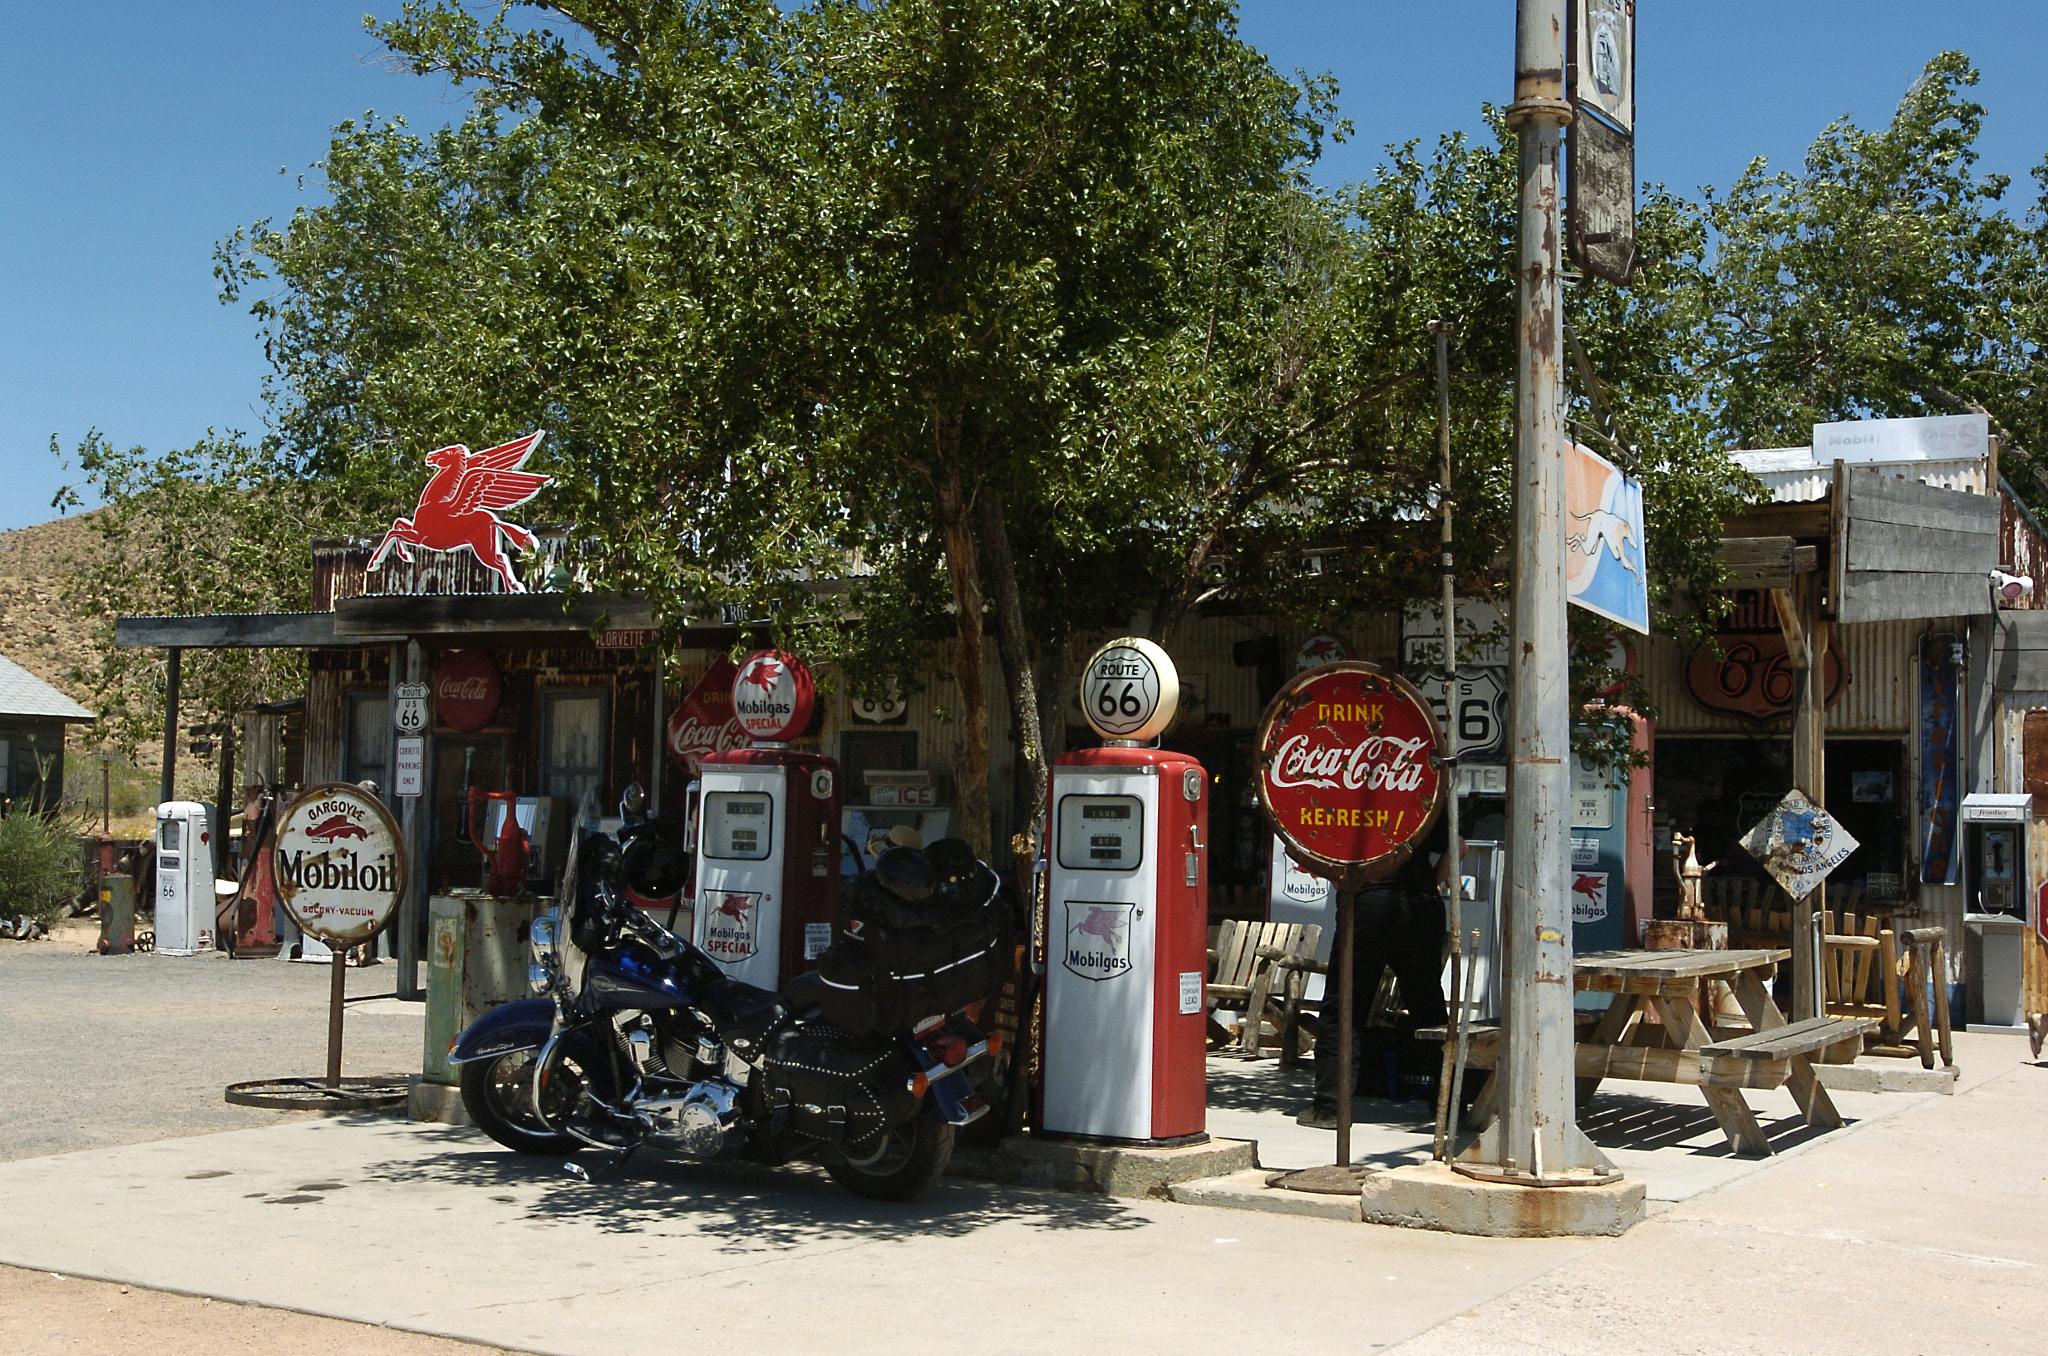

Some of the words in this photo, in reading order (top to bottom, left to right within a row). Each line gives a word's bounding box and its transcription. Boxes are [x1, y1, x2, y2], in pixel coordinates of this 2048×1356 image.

[1828, 433, 1875, 447] Mobil
[599, 630, 646, 647] CORVETTE
[1100, 664, 1140, 676] ROUTE
[1715, 643, 1794, 706] 66
[401, 688, 422, 697] ROUTE
[703, 692, 732, 704] DRIN
[1098, 682, 1141, 717] 66
[737, 700, 790, 718] Mobilgas
[1318, 704, 1385, 722] DRINK
[401, 709, 419, 727] 66
[745, 717, 783, 730] SPECIAL
[398, 762, 421, 770] PARKING
[1270, 734, 1430, 792] Coca-Cola
[1930, 641, 1949, 878] irestone
[402, 777, 416, 785] ONLY
[897, 786, 931, 804] ICE
[308, 801, 366, 822] GARGOYLE
[1815, 848, 1850, 873] ANGELES
[278, 849, 399, 893] Mobiloil
[163, 884, 175, 898] 66
[1286, 884, 1327, 898] Mobilgas
[302, 905, 374, 917] SOCONY-VACUUM
[1572, 904, 1605, 919] obilgas
[709, 926, 751, 942] Mobilgas
[707, 940, 752, 954] SPECIAL
[1069, 950, 1127, 973] Mobilgas
[1185, 996, 1198, 1005] LEAD
